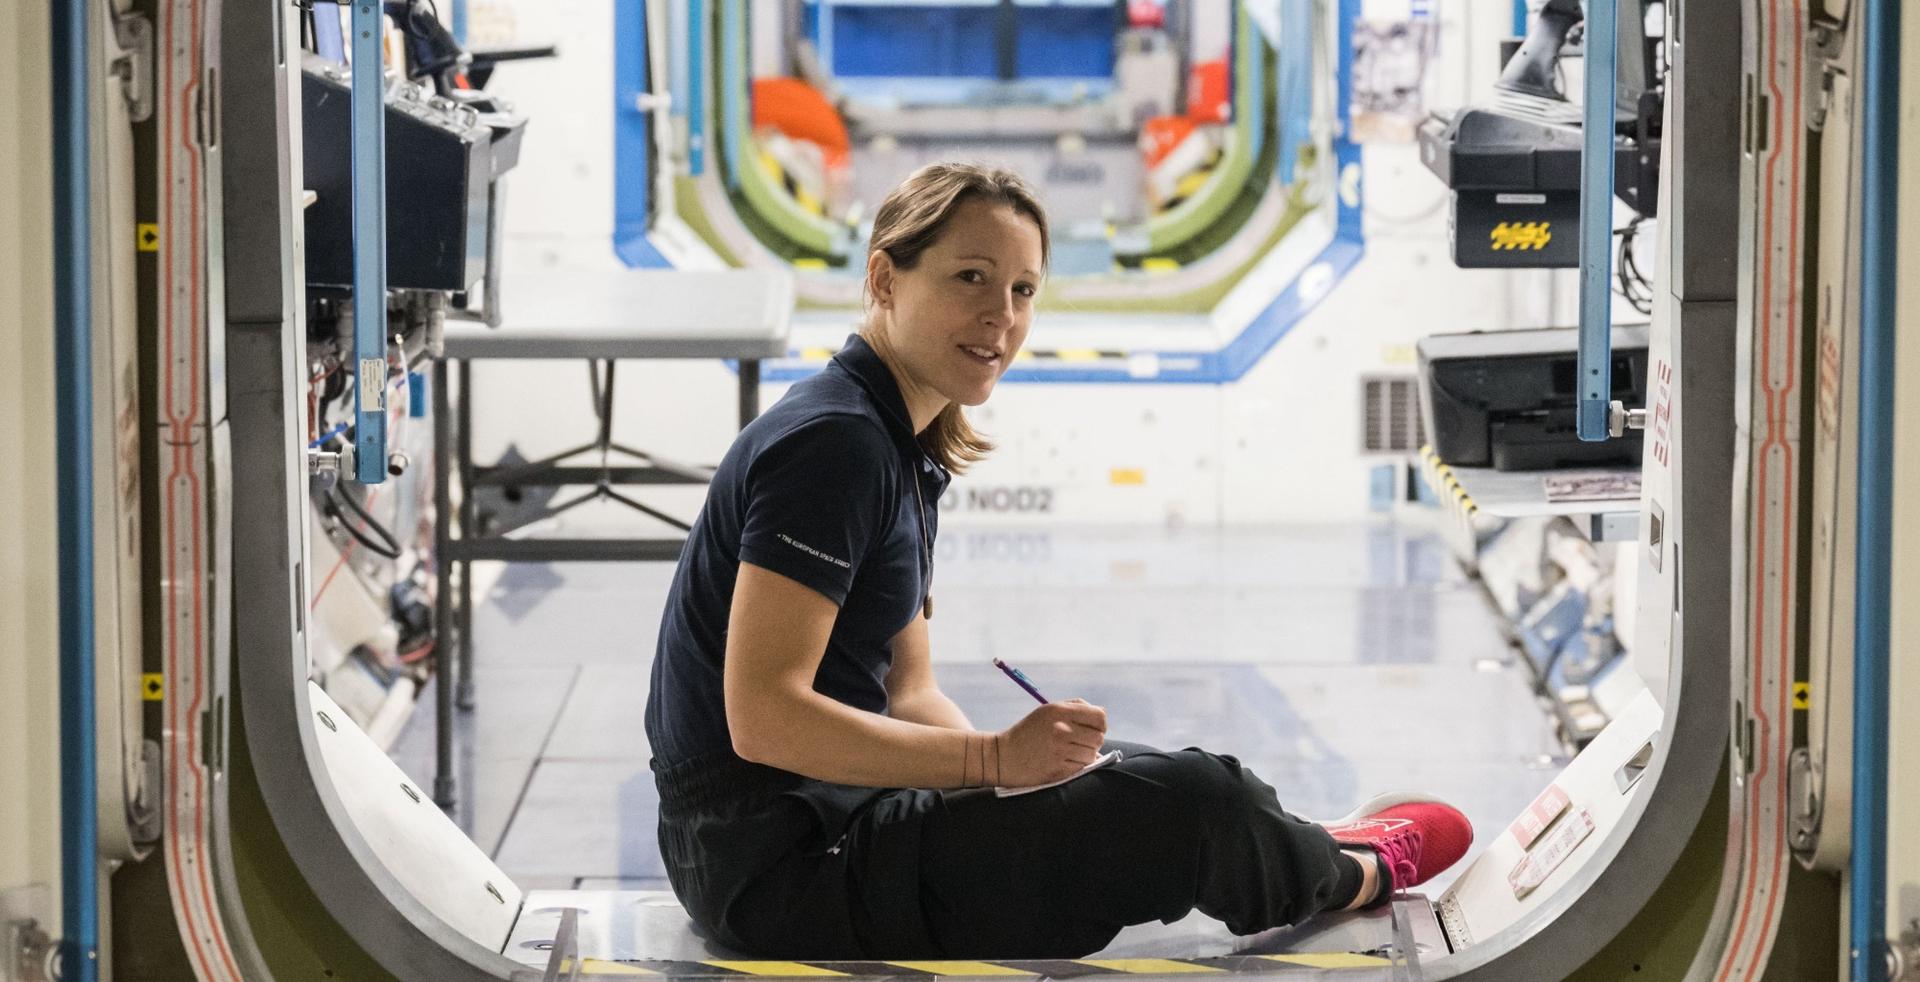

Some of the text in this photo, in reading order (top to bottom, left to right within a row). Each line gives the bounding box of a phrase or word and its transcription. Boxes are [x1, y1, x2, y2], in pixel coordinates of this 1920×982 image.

[966, 486, 1054, 512] NOD2
[781, 533, 793, 545] THE
[792, 540, 820, 557] EUROPEAN
